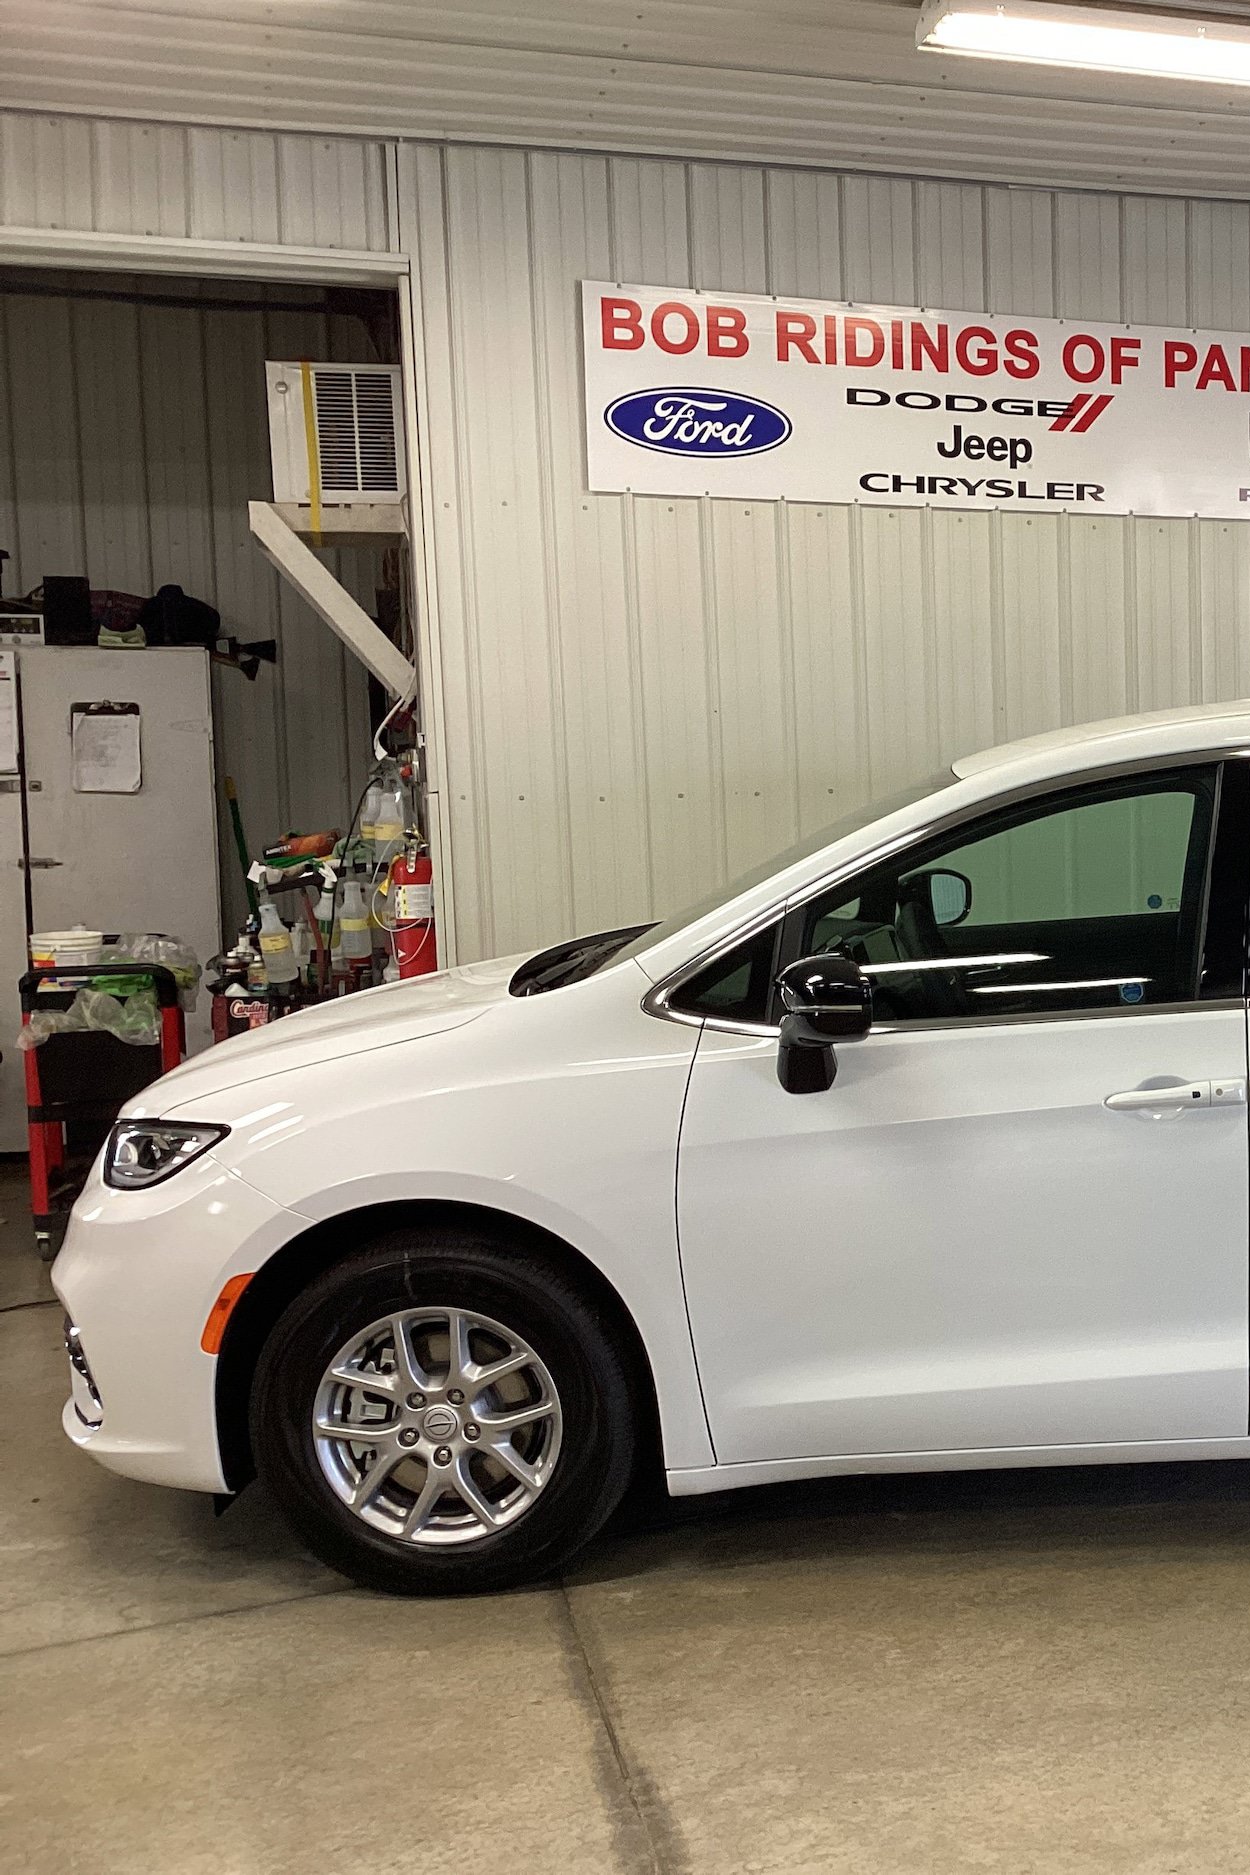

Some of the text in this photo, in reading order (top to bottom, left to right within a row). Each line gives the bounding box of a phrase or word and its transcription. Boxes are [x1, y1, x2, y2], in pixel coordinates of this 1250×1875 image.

[600, 296, 750, 359] BOB
[775, 311, 1041, 381] RIDINGS
[1061, 333, 1142, 386] OF
[642, 396, 755, 446] Ford
[846, 387, 1078, 419] DODGE
[936, 424, 1033, 470] Jeep
[859, 473, 1105, 502] CHRYSLER
